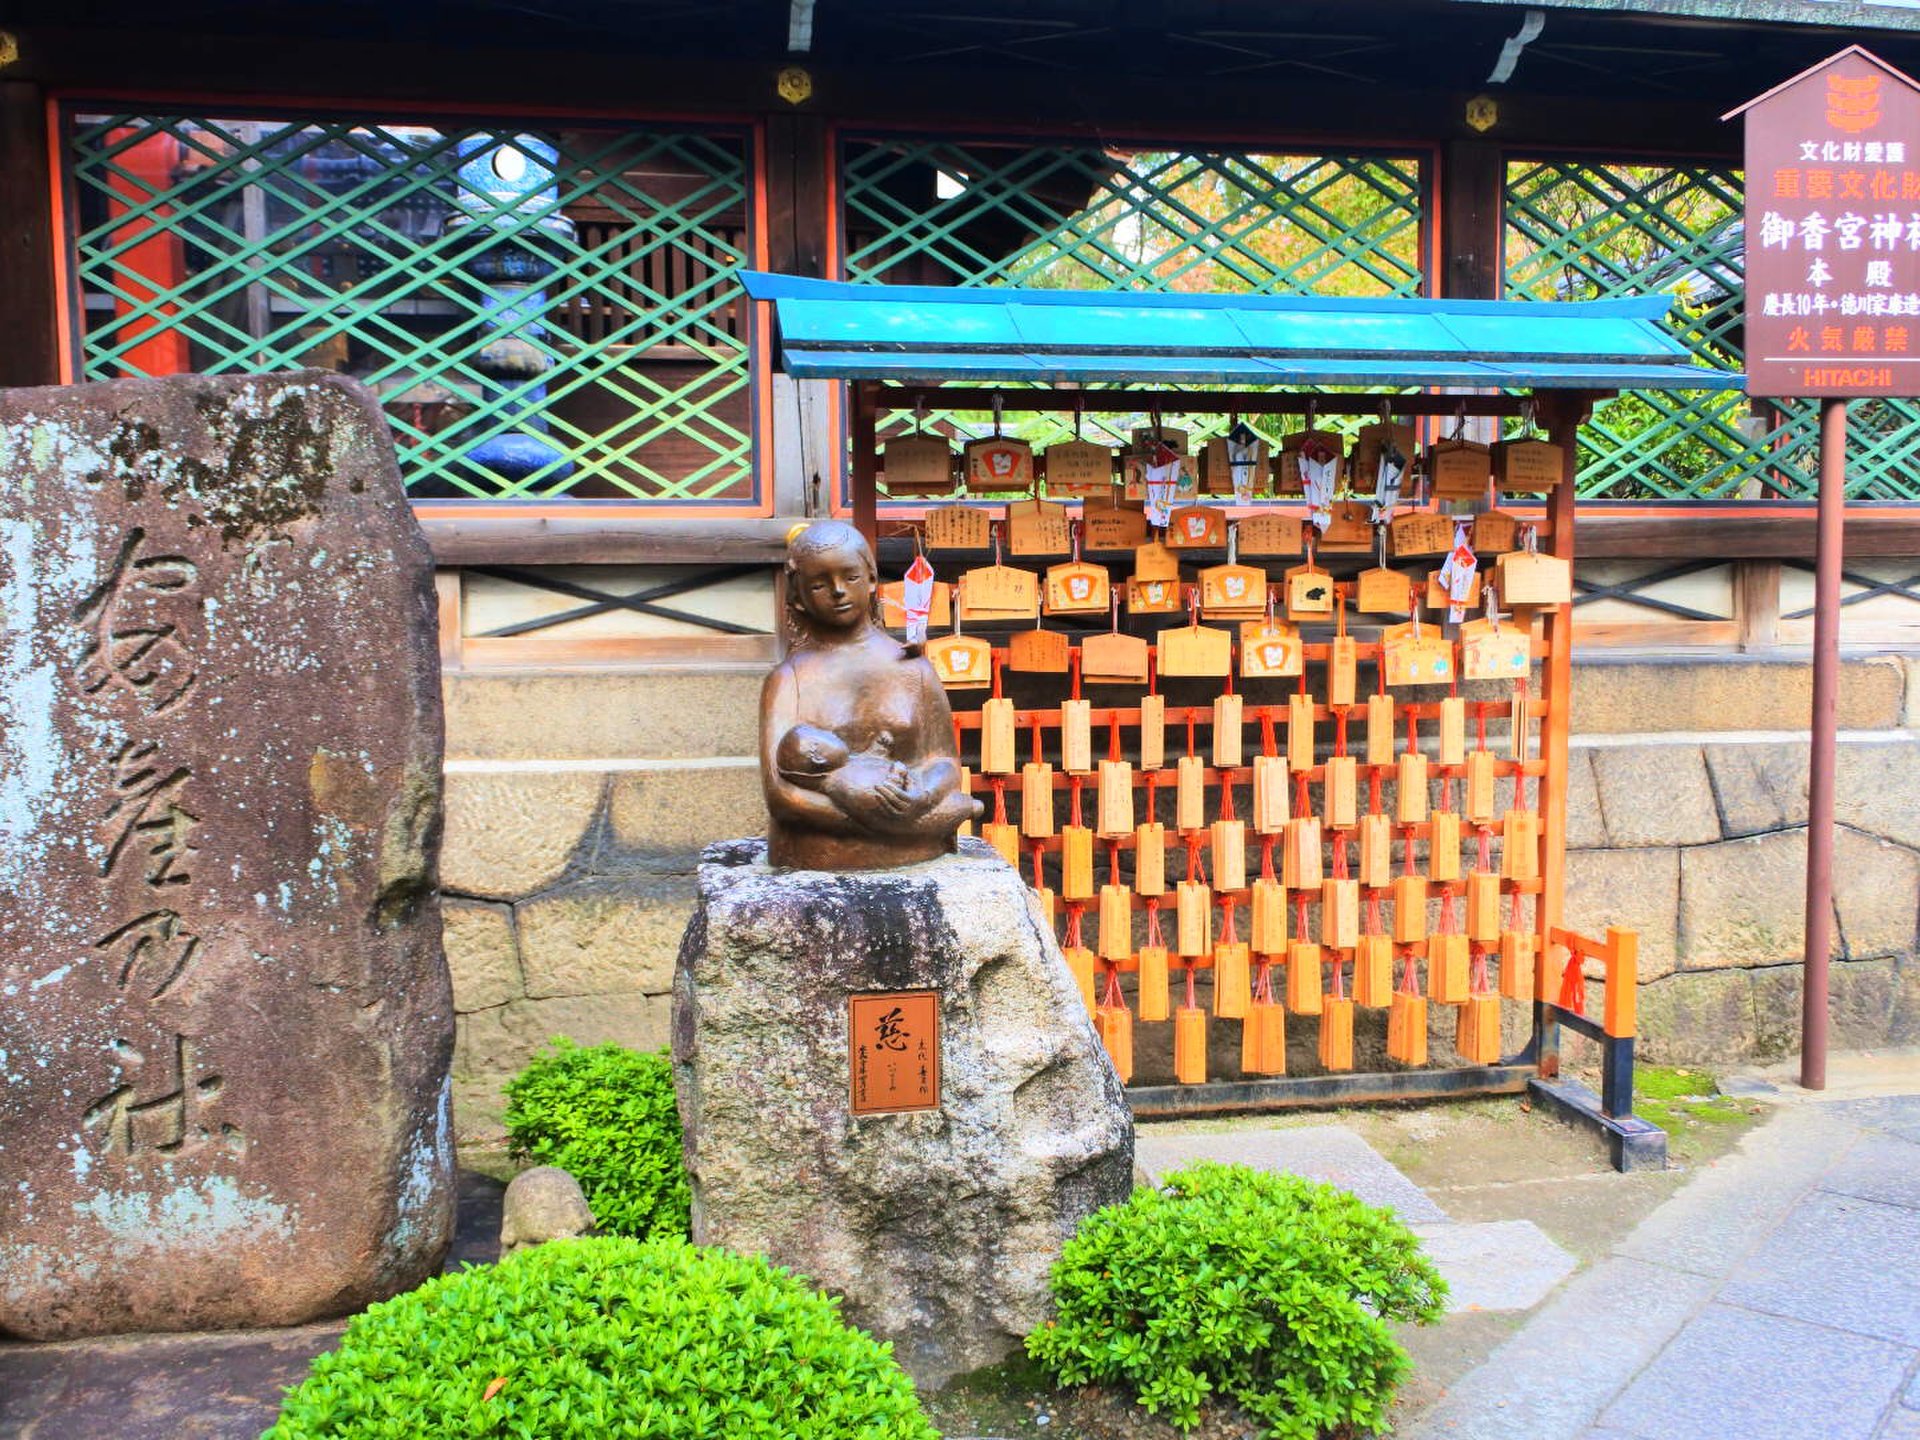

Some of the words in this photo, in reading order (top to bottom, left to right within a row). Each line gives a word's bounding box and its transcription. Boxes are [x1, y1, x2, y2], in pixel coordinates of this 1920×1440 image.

[1799, 141, 1906, 163] 文化財愛護
[1774, 169, 1920, 200] 重要文化財
[1788, 326, 1909, 352] 火気厳禁
[1804, 368, 1893, 387] HITACHI
